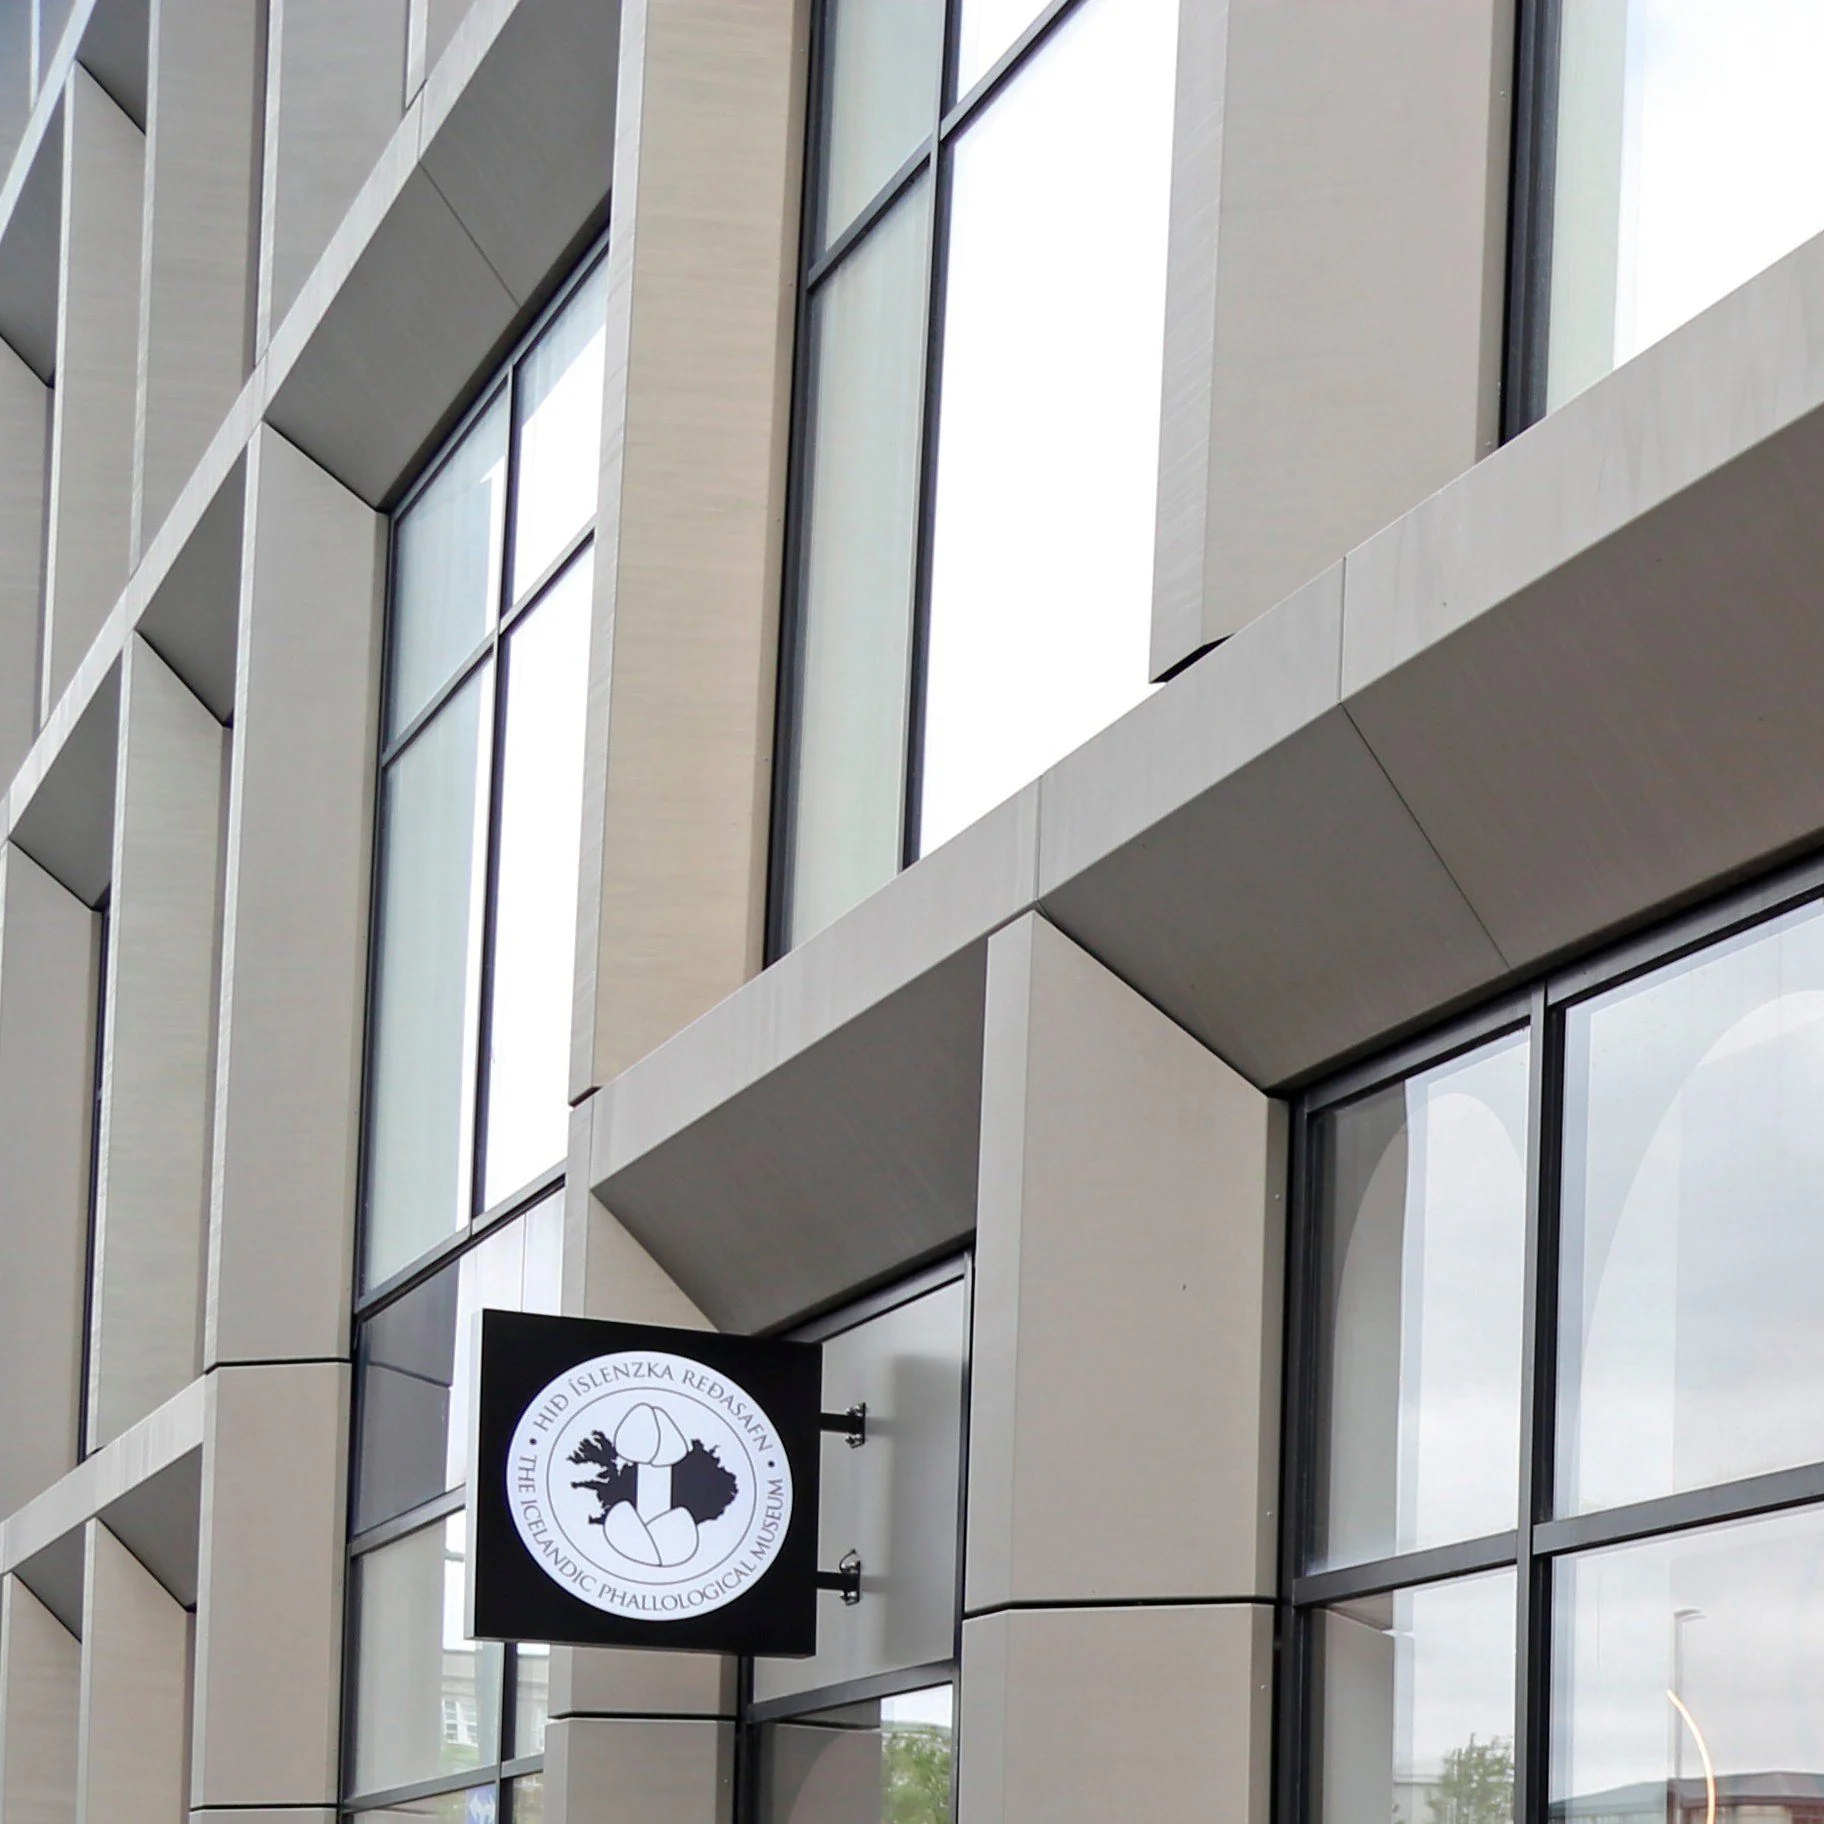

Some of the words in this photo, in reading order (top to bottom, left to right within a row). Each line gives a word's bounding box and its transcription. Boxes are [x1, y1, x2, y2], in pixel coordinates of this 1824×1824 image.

[533, 1393, 570, 1432] HIÐ
[568, 1362, 675, 1397] ÍSLENZKA
[682, 1369, 773, 1453] REÐASAFN
[518, 1454, 538, 1493] THE
[520, 1499, 597, 1592] ICELANDIC
[750, 1477, 785, 1562] MUSEUM
[597, 1560, 757, 1612] PHALLOLOGICAL
